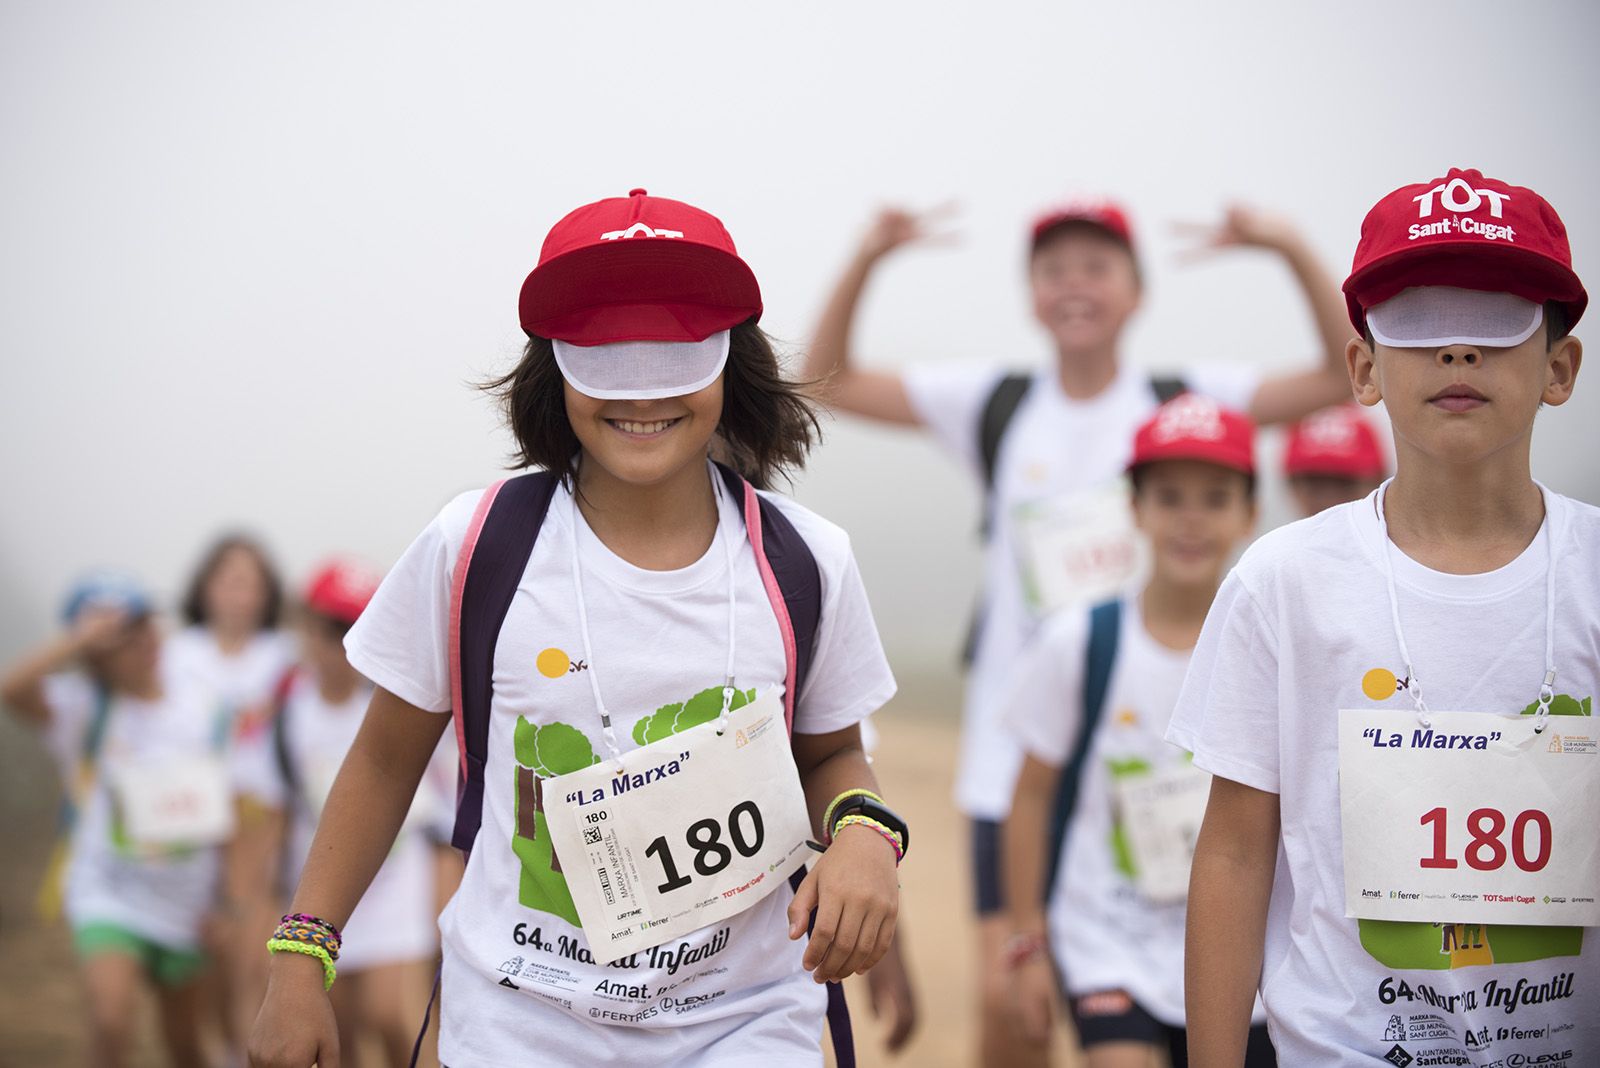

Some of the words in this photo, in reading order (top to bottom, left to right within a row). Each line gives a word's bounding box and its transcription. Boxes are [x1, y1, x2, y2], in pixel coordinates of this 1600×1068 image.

[1412, 178, 1511, 218] TOT
[1408, 218, 1451, 240] Sant
[1460, 217, 1516, 242] Cugat
[585, 810, 608, 824] 180
[645, 800, 765, 894] 180
[1420, 807, 1552, 873] 180
[604, 834, 619, 869] INFANTIL
[614, 870, 629, 898] MARXA
[722, 889, 736, 899] TOT
[1398, 891, 1420, 900] ferrer
[1483, 894, 1498, 902] TOT
[1499, 895, 1514, 903] Sant
[1516, 895, 1536, 904] Cugat
[648, 916, 669, 928] ferrer
[513, 923, 553, 952] 64a
[646, 928, 730, 976] Infantil
[594, 979, 652, 999] Amat.
[1378, 976, 1422, 1005] 64
[1483, 972, 1575, 1014] Infantil
[675, 990, 726, 1006] LEXUS
[602, 1006, 658, 1022] FERTRES
[1409, 1023, 1426, 1032] CLUB
[1410, 1030, 1427, 1038] SANT
[1511, 1026, 1545, 1040] ferrer
[1416, 1048, 1460, 1057] AJUNTAMENT
[1527, 1050, 1573, 1064] LEXUS
